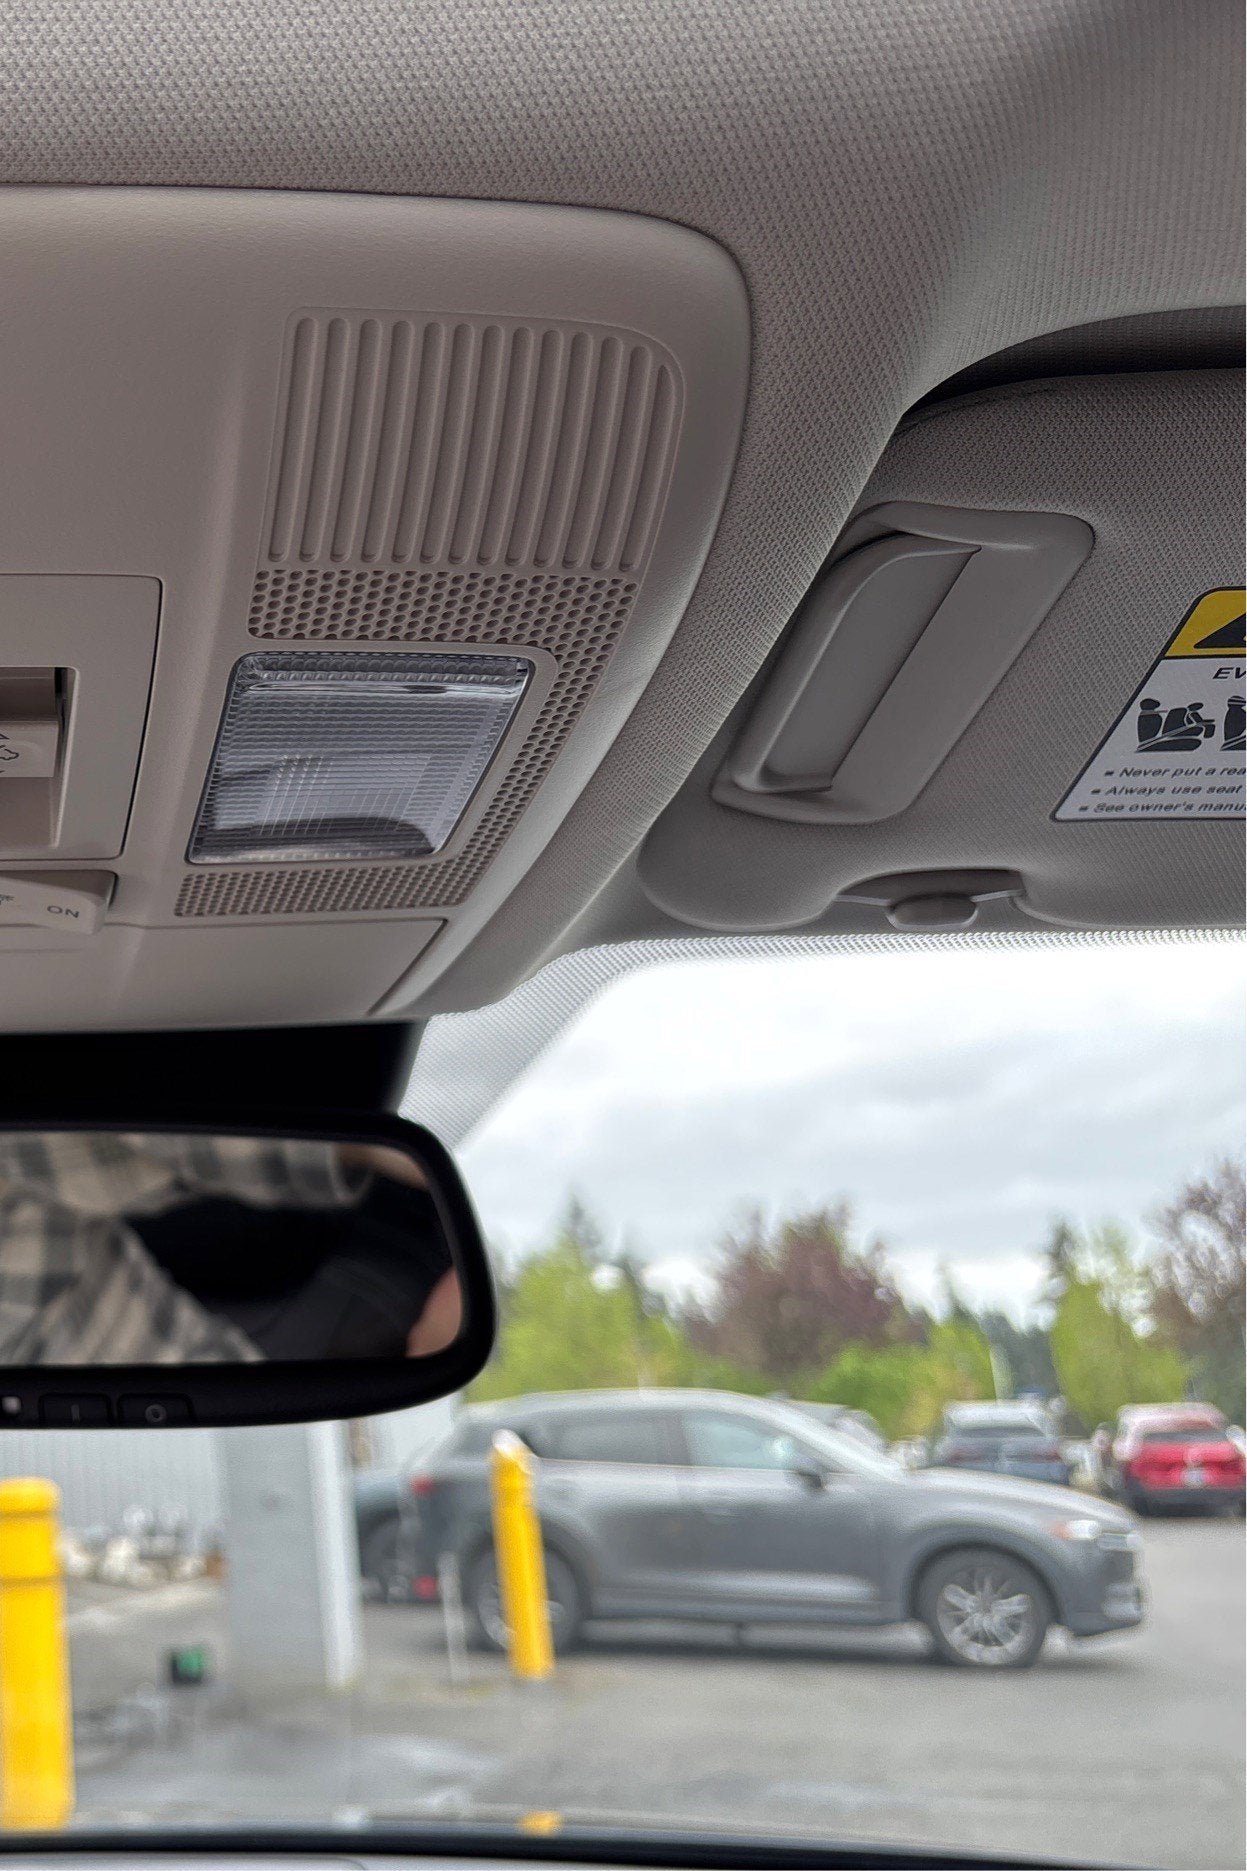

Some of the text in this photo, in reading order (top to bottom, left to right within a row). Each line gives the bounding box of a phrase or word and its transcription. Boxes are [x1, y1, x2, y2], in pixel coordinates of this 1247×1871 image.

[1119, 766, 1246, 779] Never put a rea
[1104, 784, 1244, 797] Always use seat
[1093, 801, 1246, 814] See owner's manu
[46, 904, 80, 919] ON
